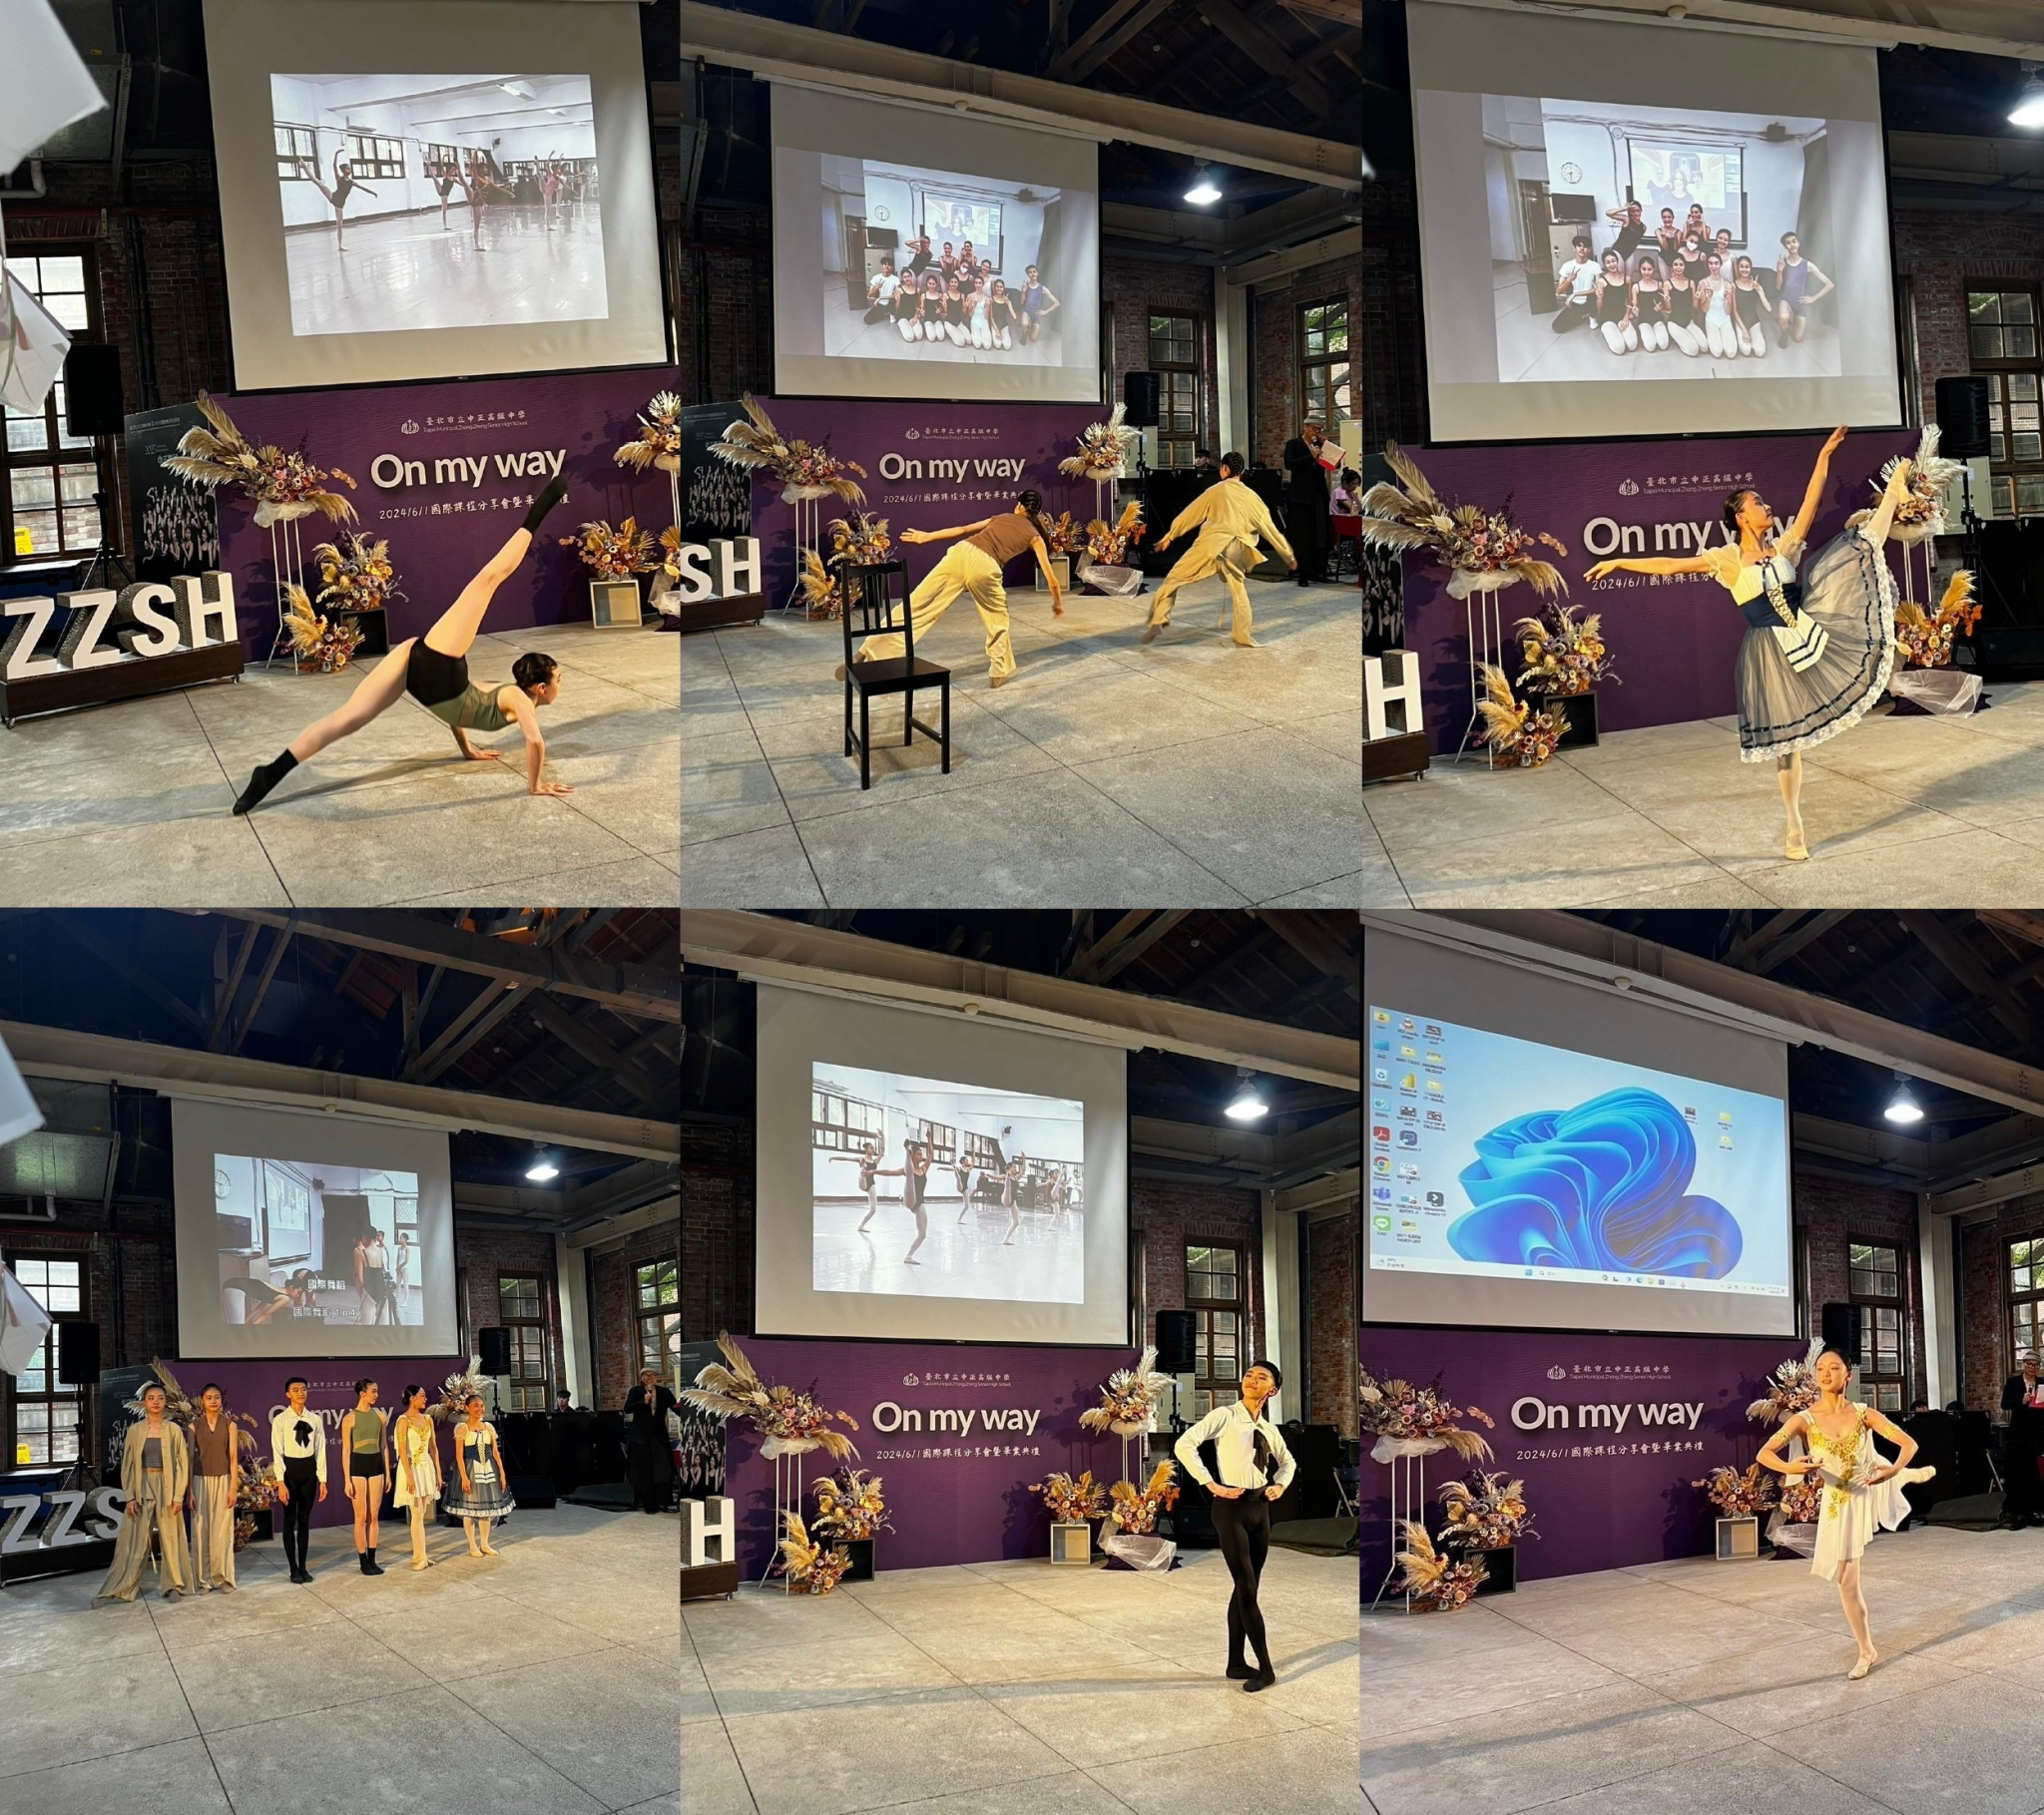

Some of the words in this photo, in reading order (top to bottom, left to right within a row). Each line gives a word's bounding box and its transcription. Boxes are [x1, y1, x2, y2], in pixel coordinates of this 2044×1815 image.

[425, 410, 526, 426] 臺北市立中正高級中學
[370, 453, 426, 488] On
[435, 455, 488, 488] my
[494, 449, 566, 480] way
[879, 453, 922, 480] On
[928, 458, 969, 483] my
[973, 458, 1026, 482] way
[1646, 472, 1754, 486] 臺北市立中正高級中學
[1583, 517, 1645, 555] On
[1655, 520, 1713, 556] my
[681, 537, 762, 604] SH
[3, 572, 238, 681] ZZSH
[1364, 652, 1423, 740] H
[1572, 1364, 1670, 1374] 臺北市立中正高級中學
[872, 1401, 921, 1432] On
[929, 1409, 975, 1437] my
[981, 1409, 1041, 1436] way
[1511, 1396, 1569, 1430] On
[1578, 1404, 1632, 1433] my
[1638, 1402, 1704, 1431] way
[691, 1498, 735, 1567] H
